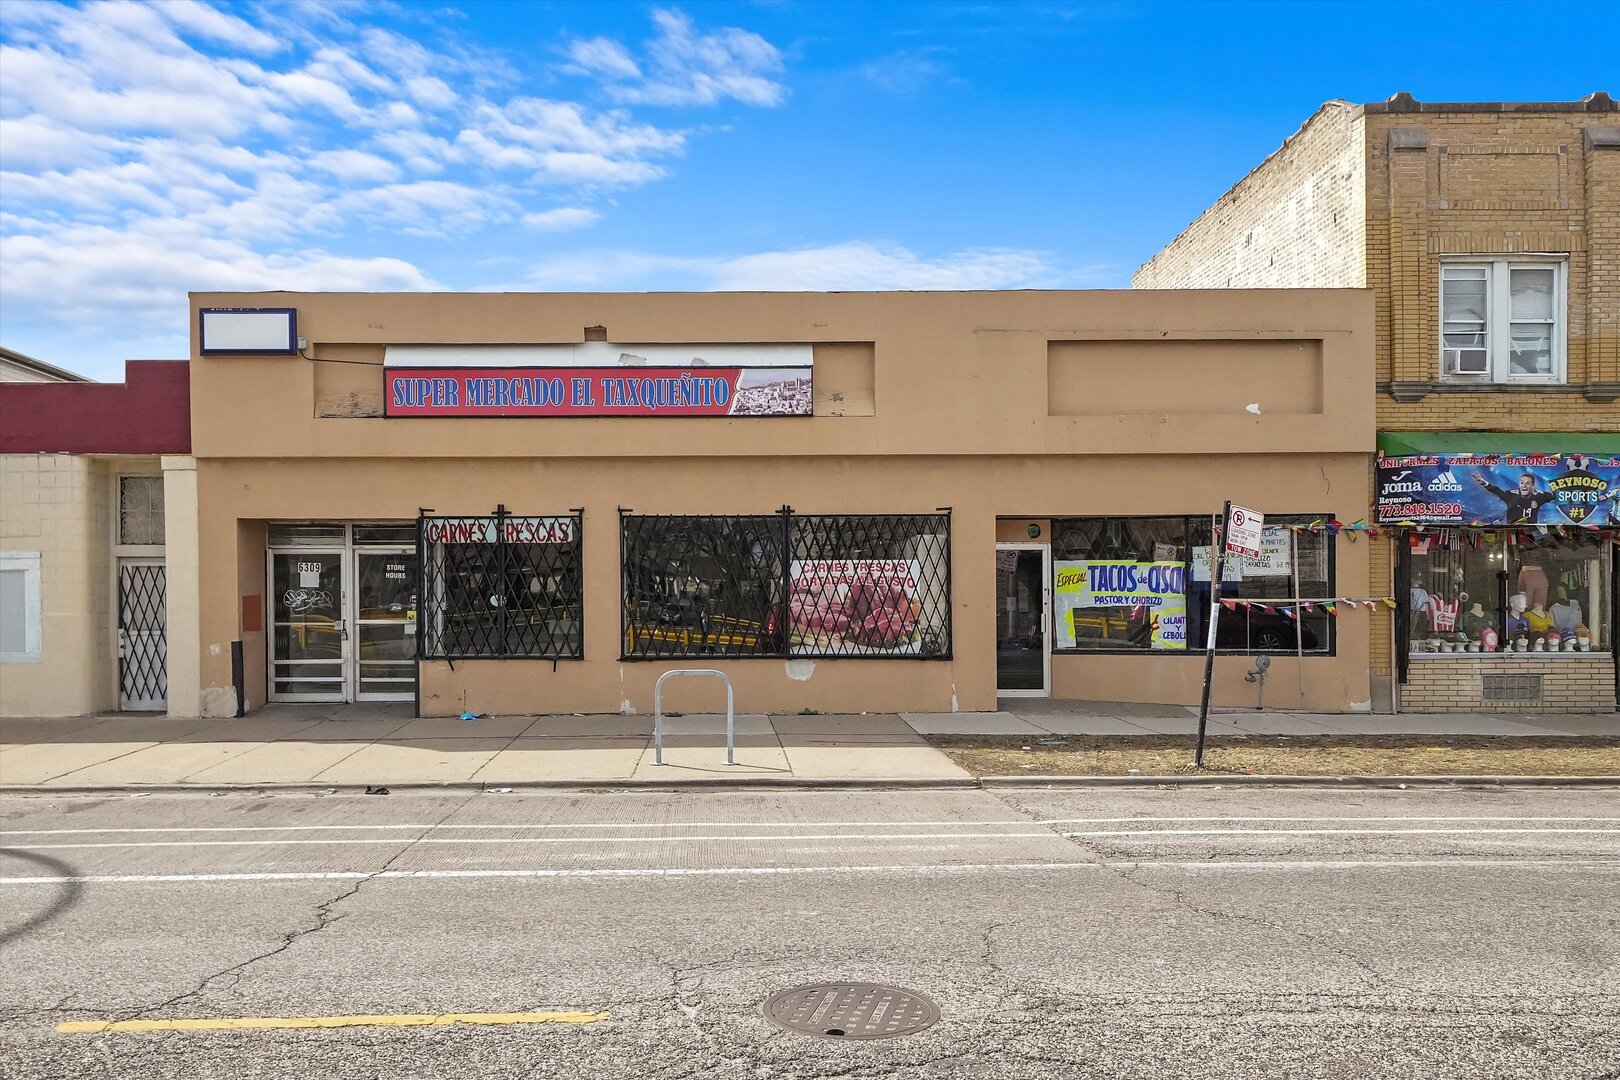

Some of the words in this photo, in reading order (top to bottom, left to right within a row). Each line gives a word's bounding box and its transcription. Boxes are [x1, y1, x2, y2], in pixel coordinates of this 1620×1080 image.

[393, 378, 460, 407] SUPER
[465, 378, 564, 407] MERCADO
[571, 378, 595, 406] EL
[601, 372, 730, 410] TAXQUEÑITO
[1380, 457, 1440, 469] UNIFRMES
[1448, 456, 1499, 466] ZAPATOS
[1506, 456, 1558, 467] BALONES
[1427, 483, 1463, 492] adidas
[1549, 476, 1608, 491] REYNOSO
[1558, 491, 1598, 502] SPORTS
[1379, 503, 1462, 516] 773.818.1520
[1569, 507, 1586, 517] #1
[428, 523, 486, 543] CARNES
[504, 522, 570, 543] RESCAS
[298, 563, 321, 573] 6309
[803, 563, 849, 573] CARNES
[1057, 572, 1087, 588] ESPECIAL
[1088, 565, 1137, 592] TACOS
[1137, 571, 1148, 584] de
[1094, 596, 1125, 604] PASTOR
[1125, 596, 1130, 604] Y
[1131, 596, 1163, 606] CHORIZO
[1163, 616, 1186, 625] CILANT
